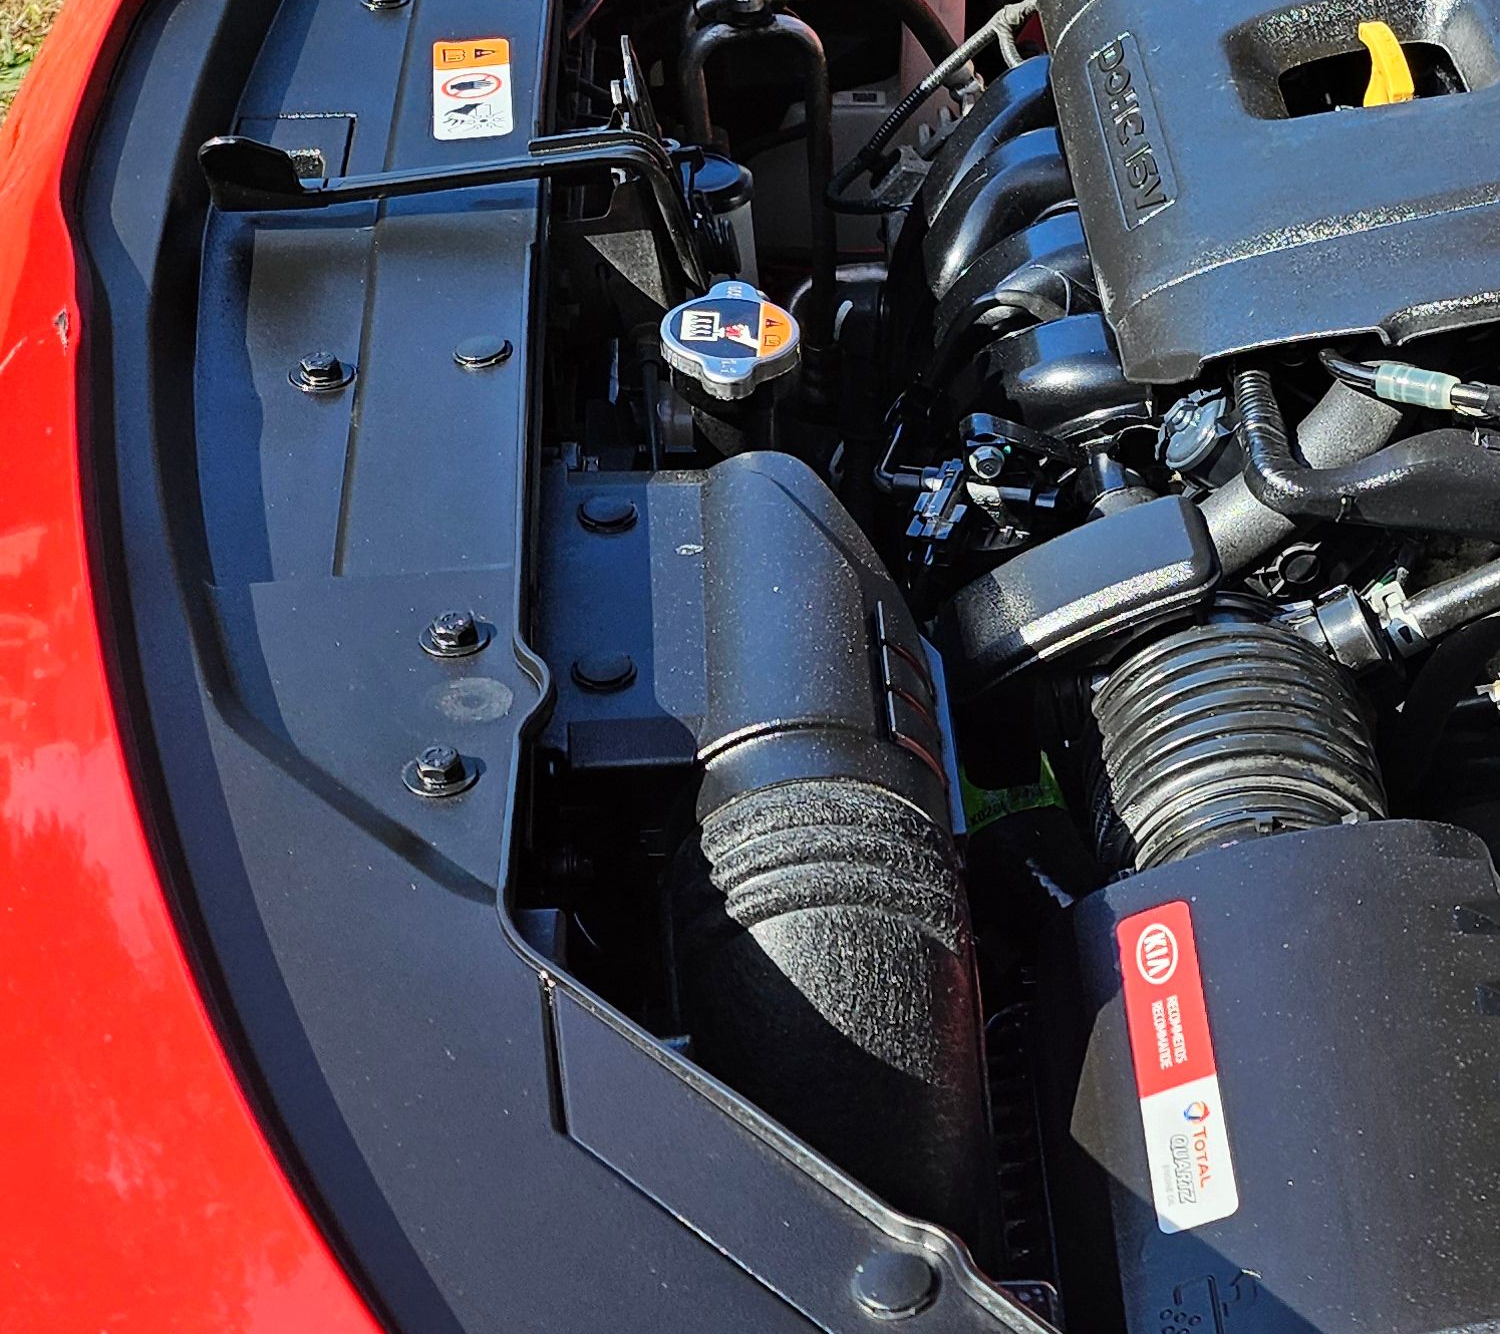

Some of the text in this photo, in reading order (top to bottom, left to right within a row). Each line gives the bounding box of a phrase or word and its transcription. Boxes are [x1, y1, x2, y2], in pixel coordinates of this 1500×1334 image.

[1098, 40, 1167, 210] DOHC 16V
[1170, 1133, 1197, 1204] QUARTZ
[1193, 1125, 1212, 1188] TOTAL
